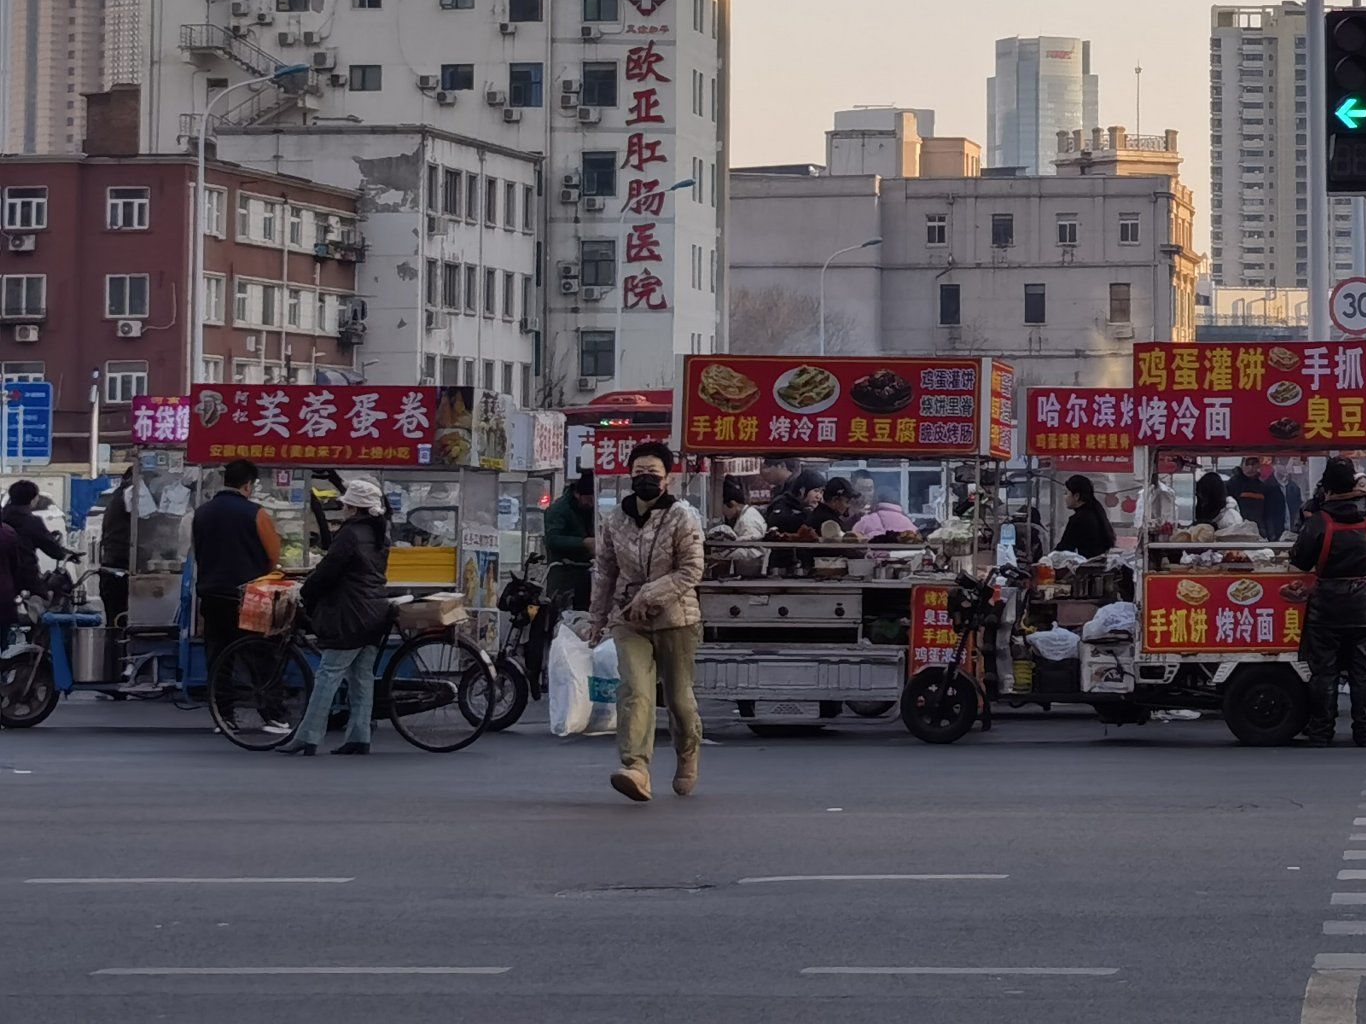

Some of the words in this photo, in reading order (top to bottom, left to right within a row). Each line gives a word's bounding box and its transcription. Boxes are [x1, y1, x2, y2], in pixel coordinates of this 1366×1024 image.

[620, 39, 671, 310] 欧亚肛肠医院
[920, 368, 976, 390] 鸡蛋灌饼
[1138, 347, 1265, 391] 鸡蛋灌饼
[252, 390, 430, 439] 芙蓉蛋卷
[690, 415, 759, 441] 手抓饼
[768, 415, 838, 442] 烤冷面
[848, 416, 917, 443] 臭豆腐
[918, 422, 974, 444] 脆皮烤肠
[1137, 396, 1231, 441] 烤冷面
[1150, 608, 1208, 644] 手抓饼
[1216, 607, 1274, 644] 烤冷面
